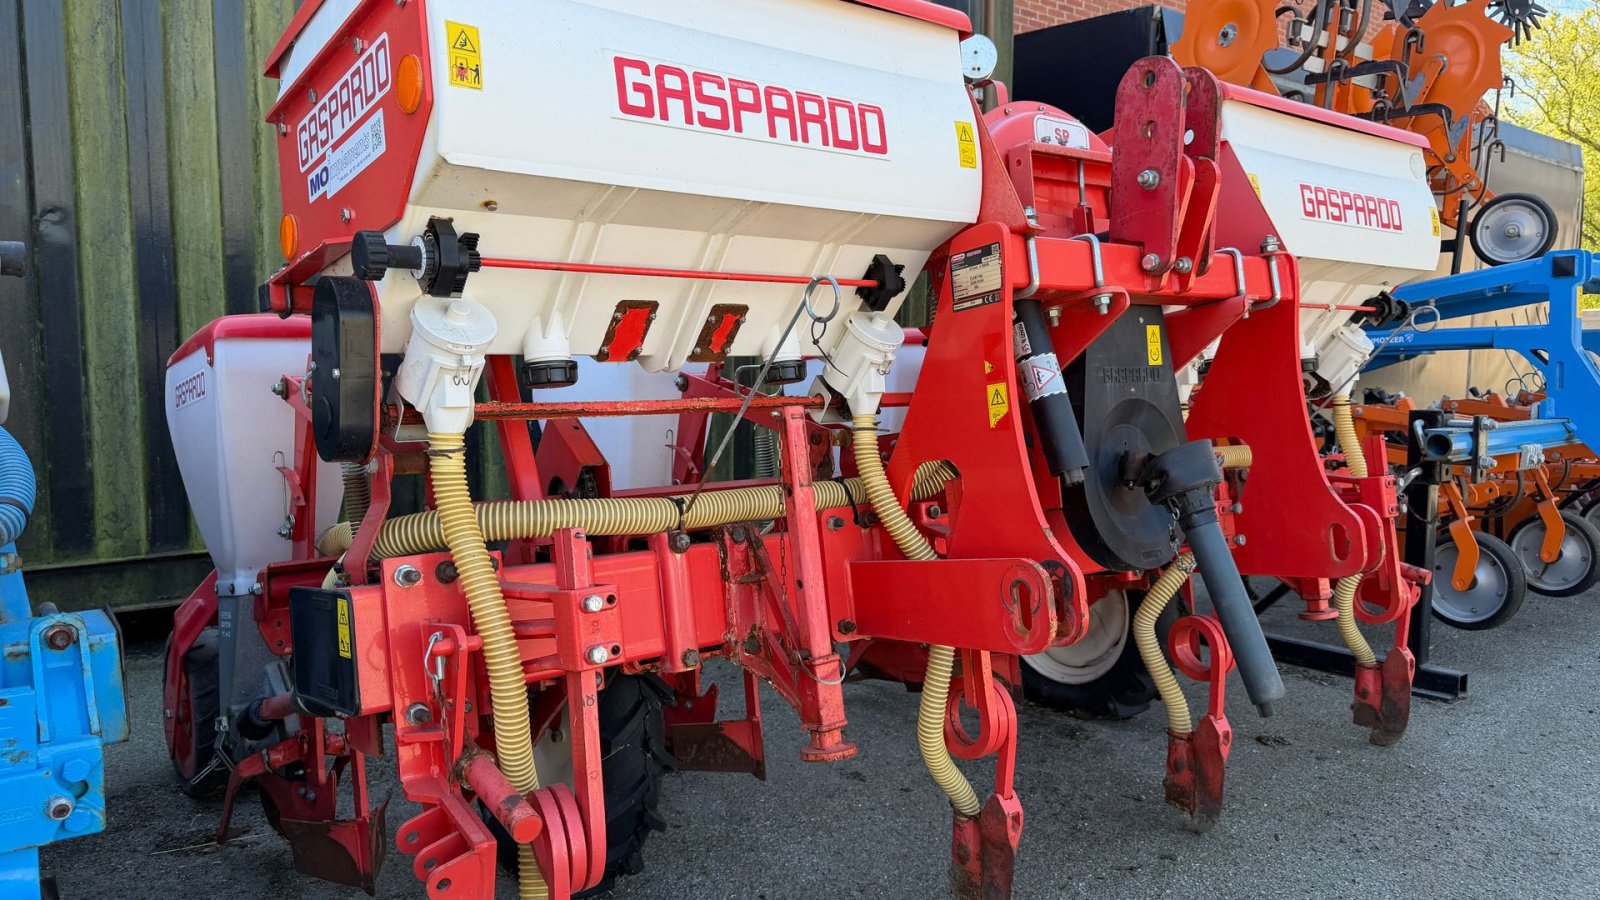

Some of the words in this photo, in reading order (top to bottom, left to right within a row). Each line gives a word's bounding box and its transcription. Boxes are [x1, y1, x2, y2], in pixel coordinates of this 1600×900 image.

[299, 38, 390, 168] GASPARDO
[613, 56, 888, 155] GASPARDO
[1299, 183, 1403, 231] GASPARDO
[175, 371, 206, 409] GASPARDO
[1103, 367, 1160, 383] GASPARDO
